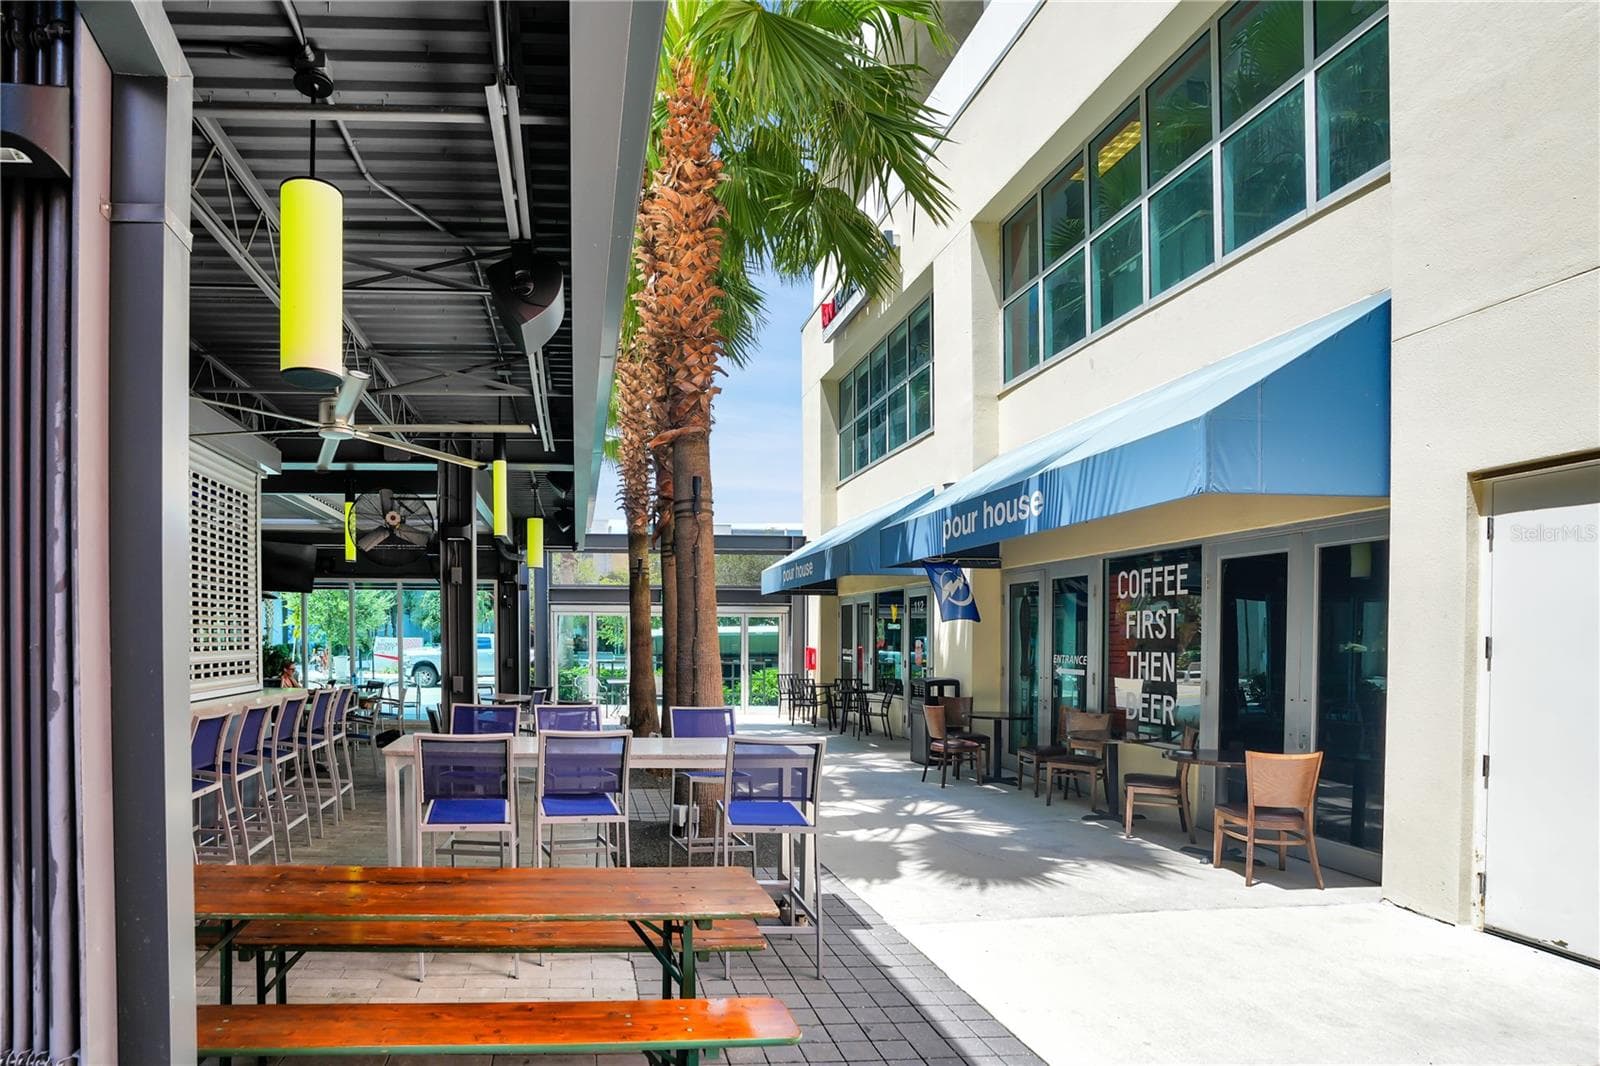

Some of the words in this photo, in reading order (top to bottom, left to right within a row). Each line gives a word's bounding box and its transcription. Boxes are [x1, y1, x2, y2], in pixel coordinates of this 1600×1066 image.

[942, 510, 978, 548] pour
[983, 490, 1044, 530] house
[795, 561, 814, 579] house
[1117, 562, 1189, 599] COFFEE
[1125, 608, 1179, 639] FIRST
[1053, 654, 1088, 666] ENTRANCE
[1126, 651, 1176, 682] THEN
